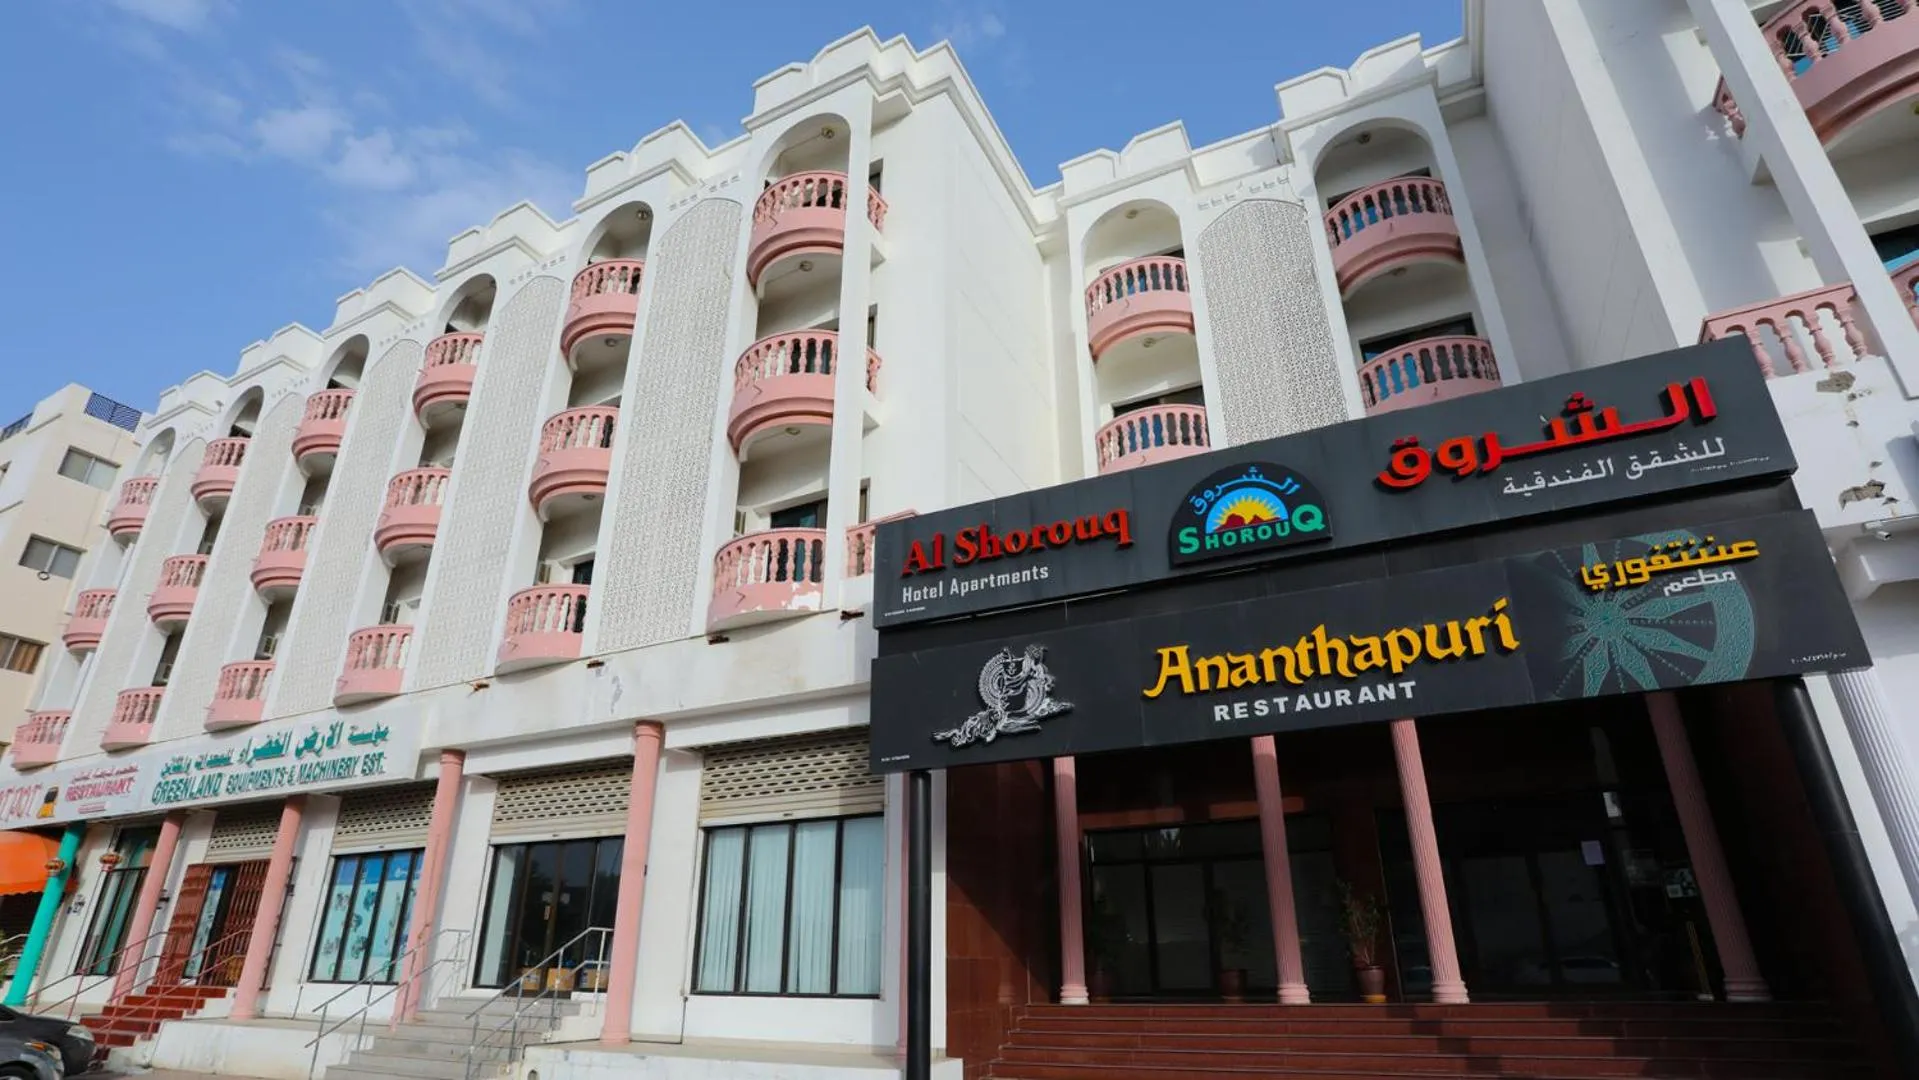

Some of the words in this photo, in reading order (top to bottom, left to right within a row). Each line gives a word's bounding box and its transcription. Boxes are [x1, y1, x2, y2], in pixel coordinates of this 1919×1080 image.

[1374, 377, 1718, 488] الشروق
[1503, 457, 1615, 496] الفندقية
[1626, 437, 1726, 480] للشقق
[1189, 465, 1301, 516] الشروق
[902, 535, 945, 576] Al
[954, 508, 1133, 563] Shorouq
[902, 580, 944, 604] Hotel
[949, 564, 1050, 597] Apartments
[1662, 568, 1737, 597] مطعم
[1142, 596, 1521, 700] Ananthapuri
[1213, 679, 1418, 723] RESTAURANT
[151, 771, 223, 805] GREENLAND
[299, 756, 360, 784] MACHINERY
